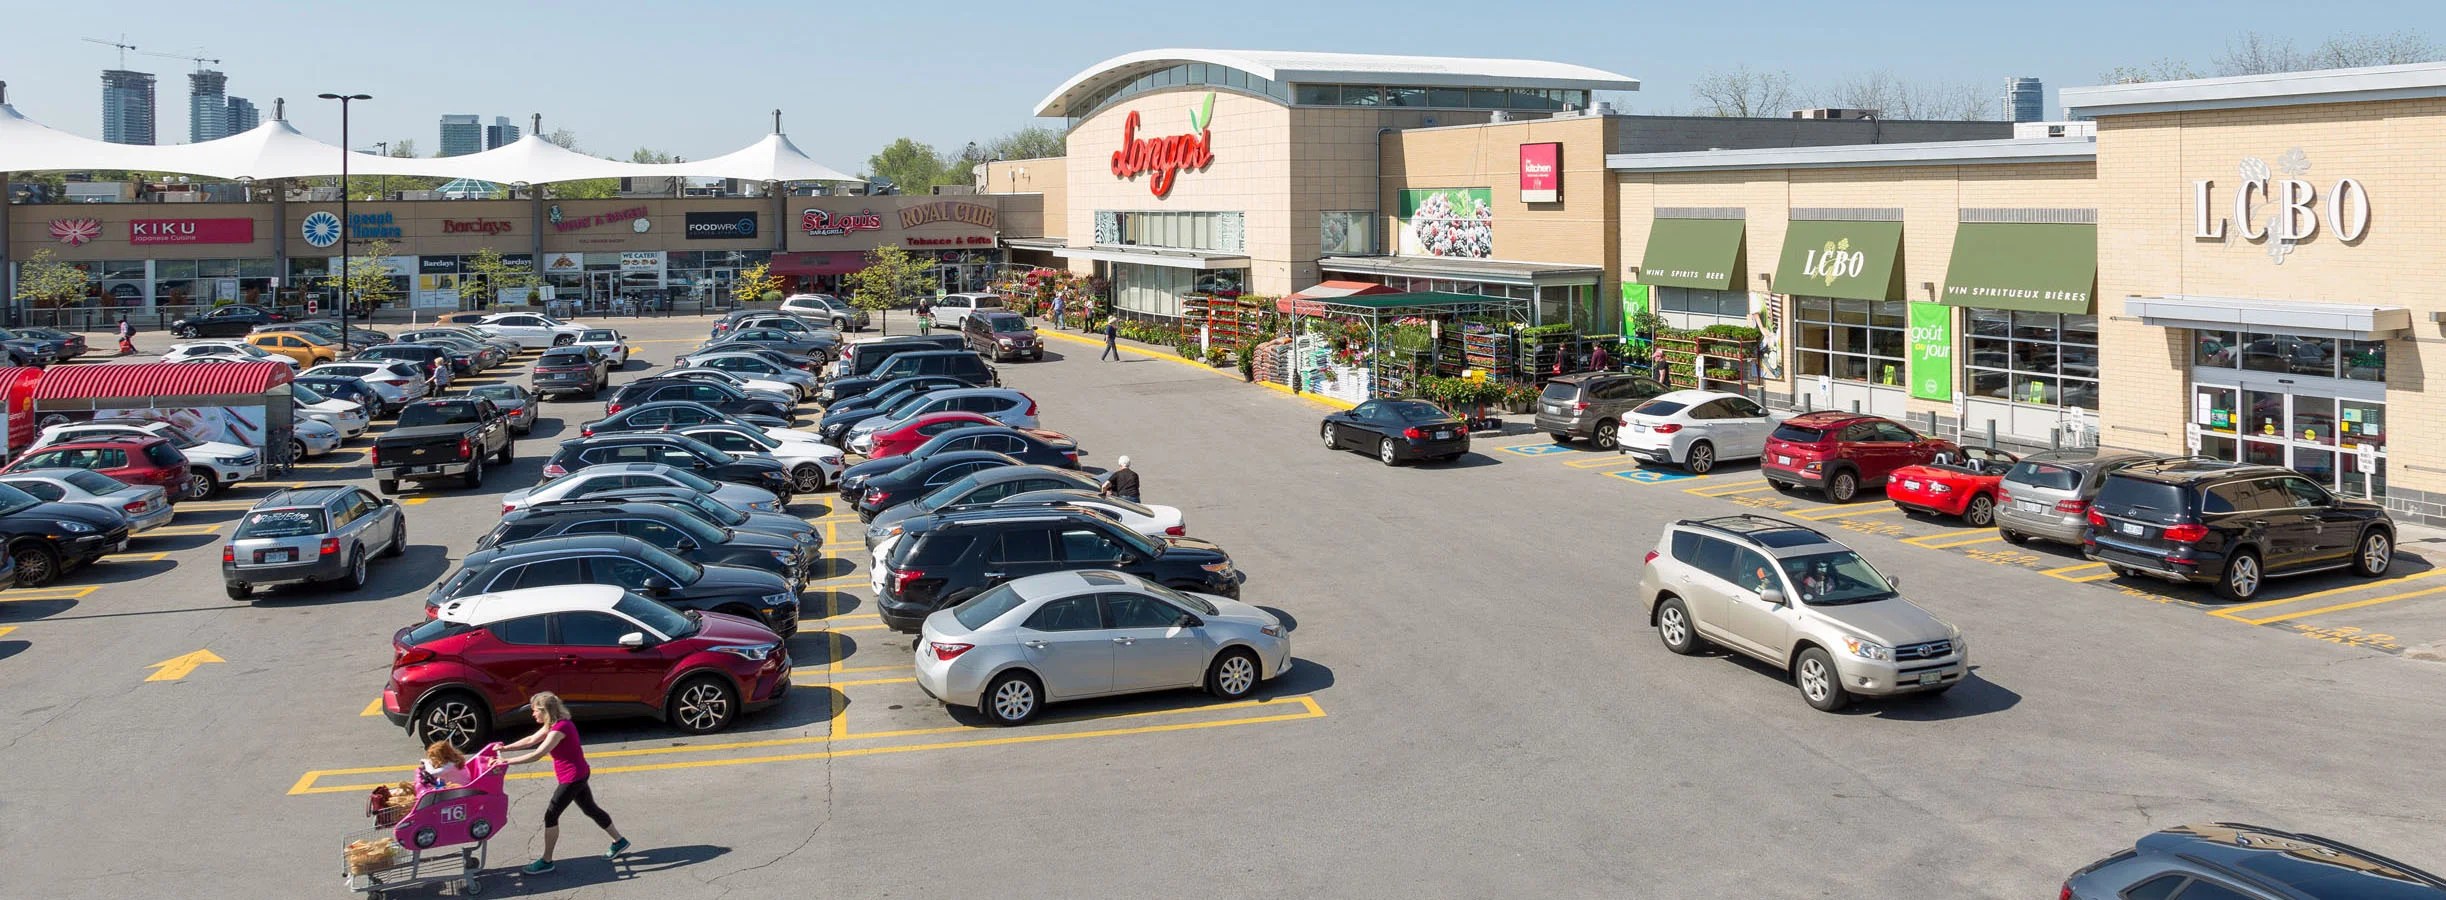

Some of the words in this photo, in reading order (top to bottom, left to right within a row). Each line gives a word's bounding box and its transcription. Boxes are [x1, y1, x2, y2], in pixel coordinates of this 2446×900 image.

[1525, 162, 1552, 173] kitchen
[901, 202, 950, 229] ROYAL
[954, 203, 995, 228] CLUB
[2193, 178, 2370, 242] LCBO
[133, 222, 195, 235] KIKU
[442, 218, 512, 235] Barclays
[906, 237, 952, 246] Tobacco
[966, 236, 993, 245] Gifts
[423, 260, 454, 268] Barclays
[502, 258, 532, 266] Barclays
[1802, 249, 1865, 278] LCBO
[1646, 269, 1664, 277] WINE
[1671, 270, 1699, 279] SPIRITS
[1705, 271, 1725, 280] BEER
[1948, 286, 1968, 295] VIN
[1972, 286, 2040, 299] SPIRITUEUX
[2044, 290, 2087, 302] BIÈRES
[1911, 324, 1944, 343] goût
[1922, 341, 1950, 361] jour
[441, 806, 464, 821] 16
